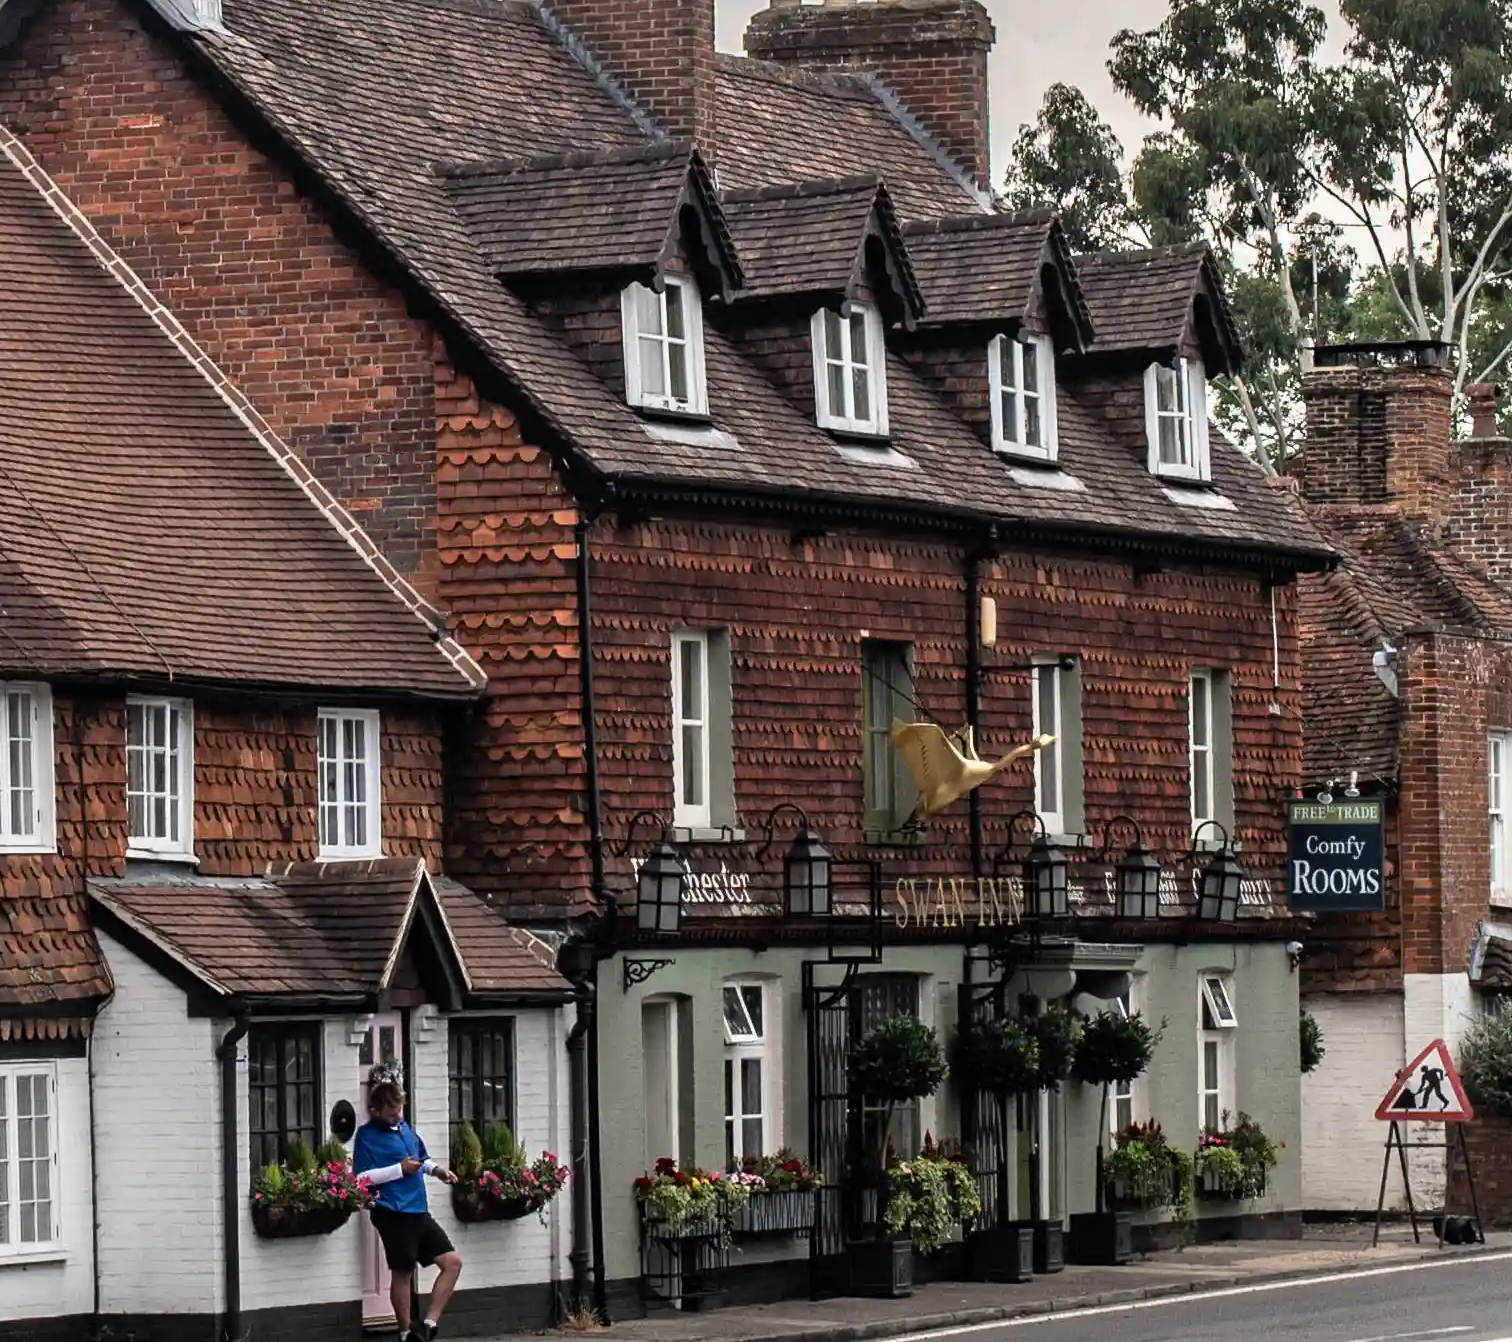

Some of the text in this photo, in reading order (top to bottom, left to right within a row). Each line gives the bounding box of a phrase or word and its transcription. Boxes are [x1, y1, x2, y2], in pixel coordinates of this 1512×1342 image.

[1294, 806, 1326, 820] FREE
[1337, 805, 1378, 821] TRADE
[1306, 835, 1366, 860] Comfy
[1292, 859, 1380, 894] ROOMS
[895, 877, 966, 929] SWAN
[977, 877, 1024, 928] INN
